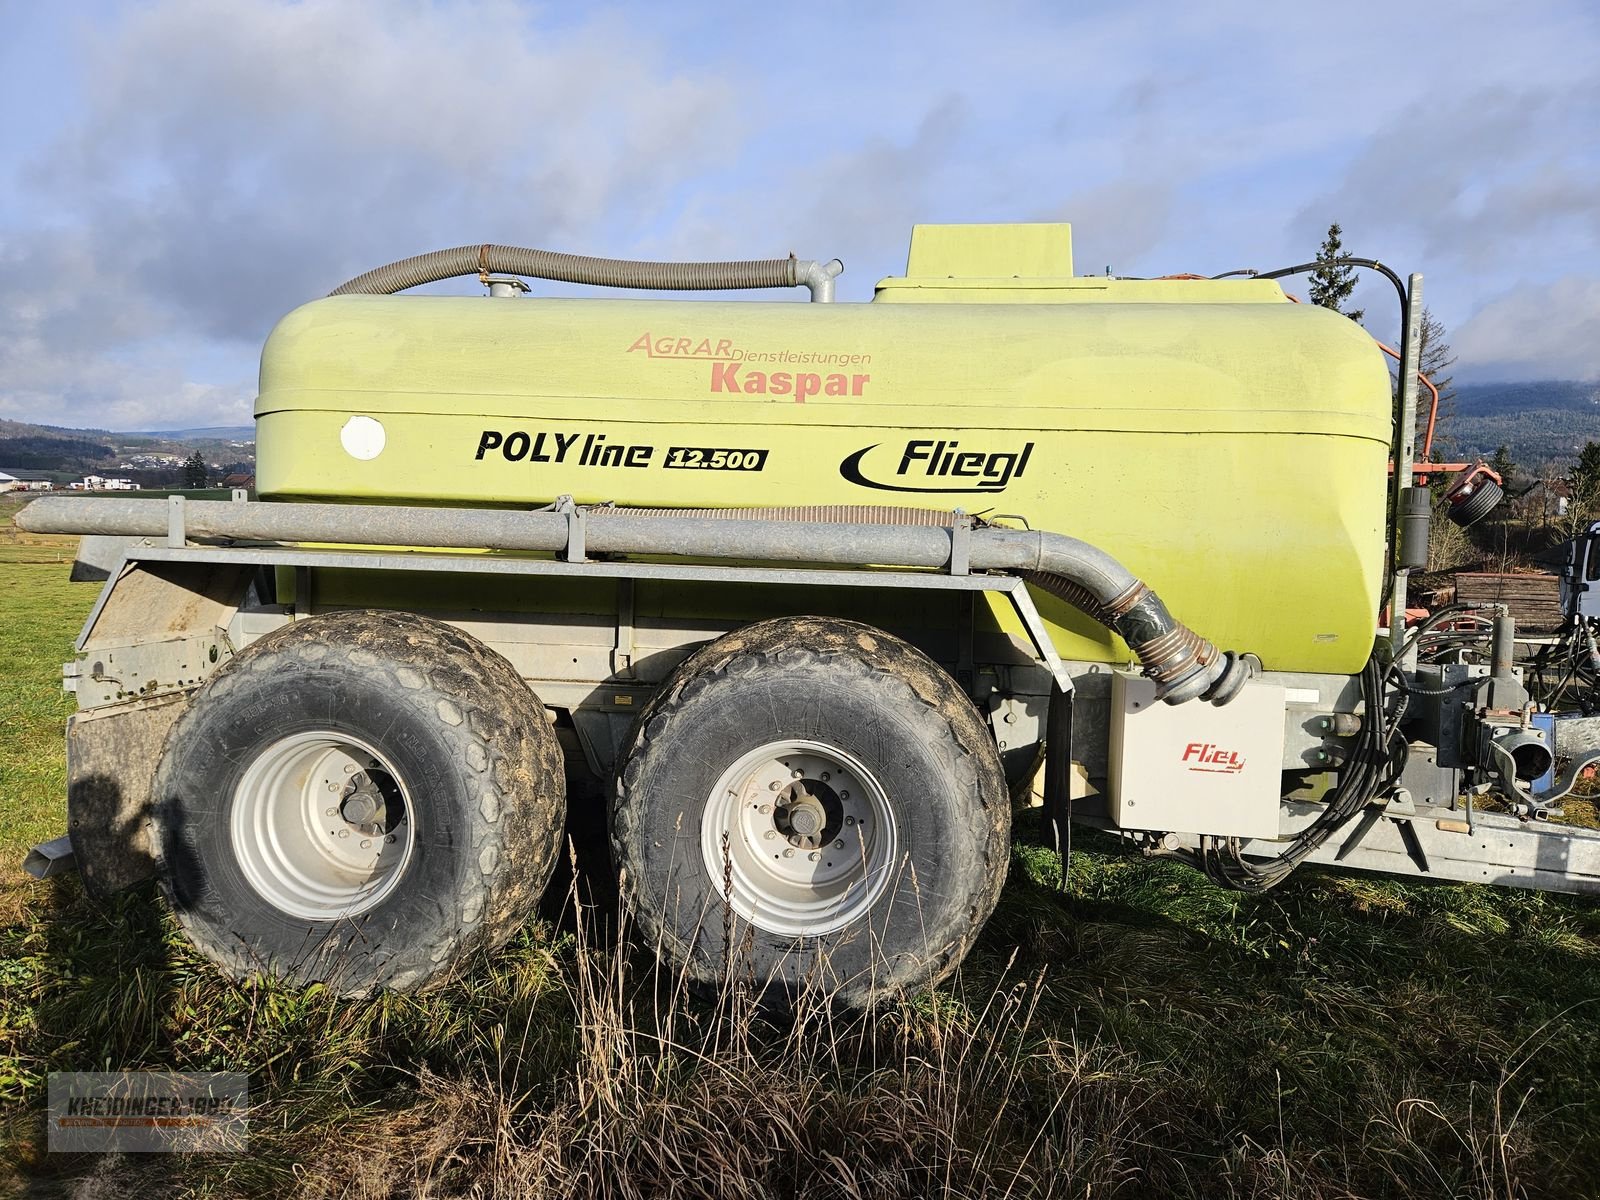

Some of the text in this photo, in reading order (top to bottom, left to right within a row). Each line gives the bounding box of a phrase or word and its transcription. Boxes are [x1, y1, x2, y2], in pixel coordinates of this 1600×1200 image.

[626, 332, 872, 367] AGRAR Dienstleistungen
[710, 362, 870, 403] Kaspar
[475, 431, 580, 463] POLY
[668, 449, 761, 470] 12.500
[896, 440, 1035, 487] Fliegl
